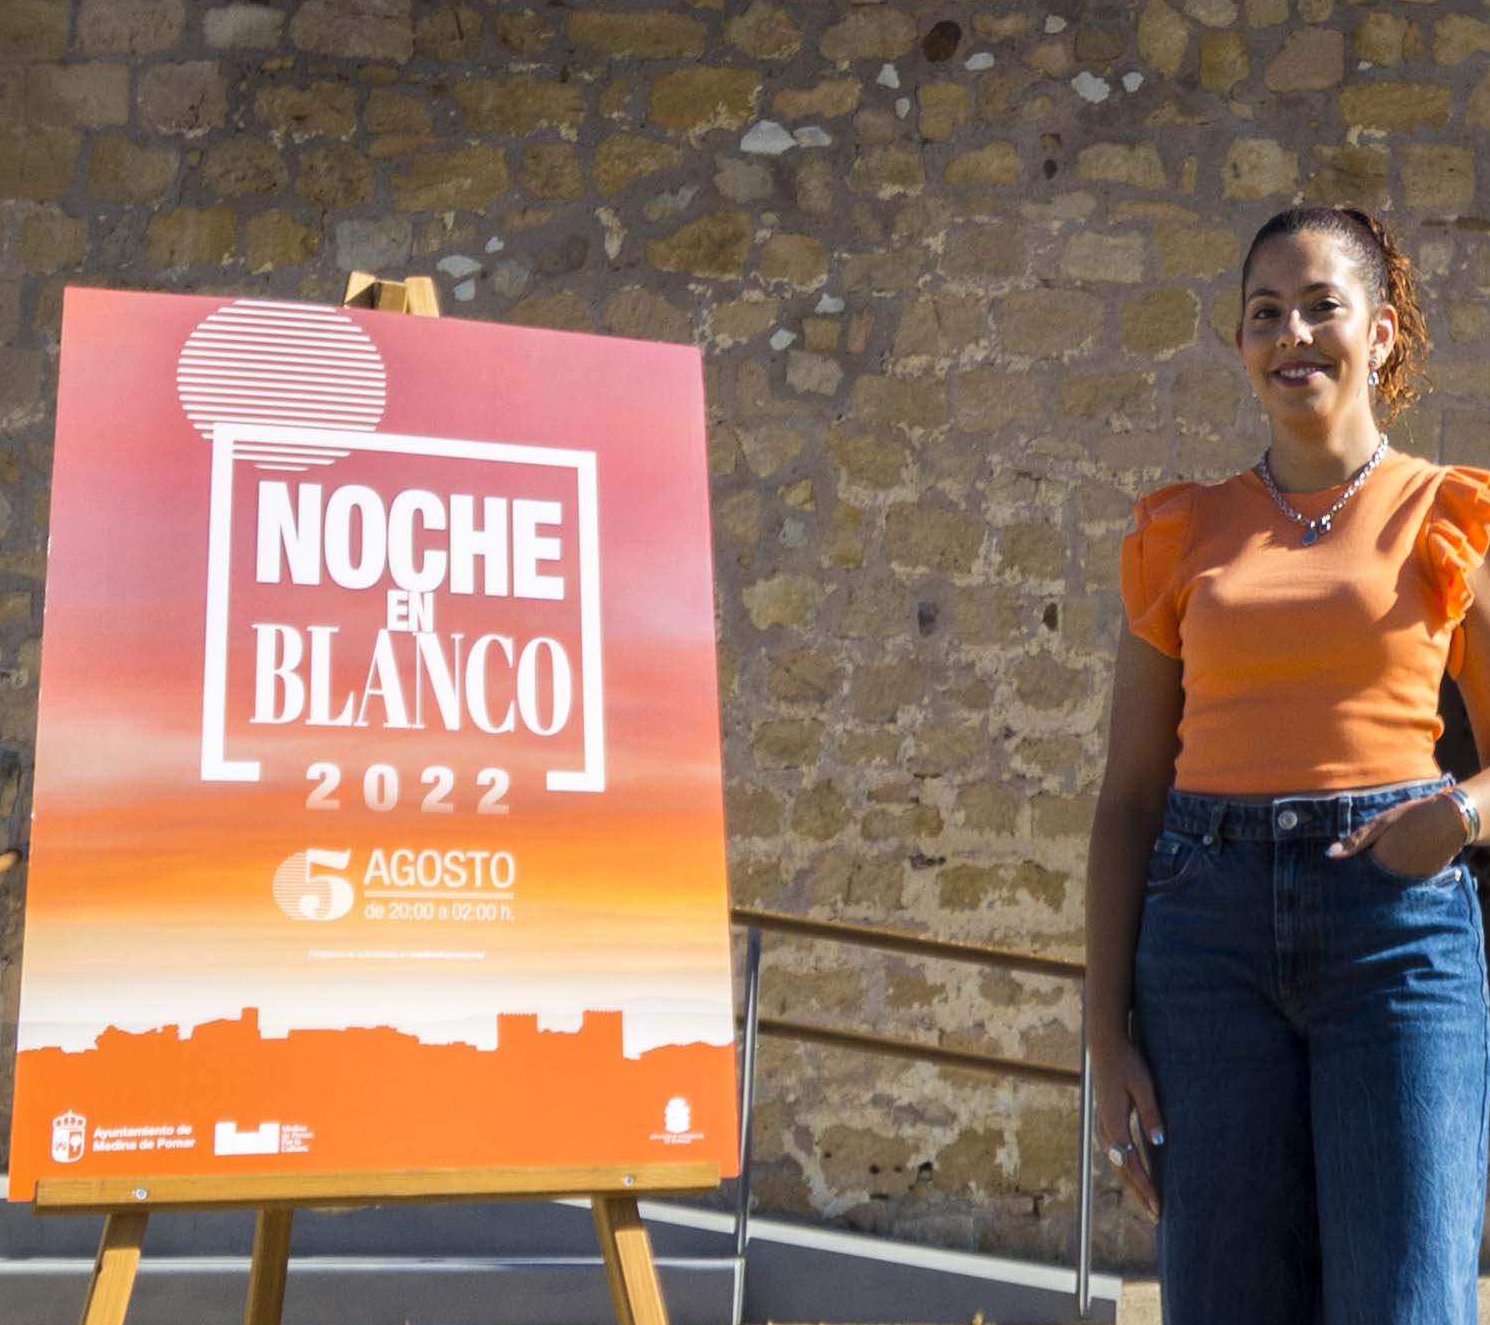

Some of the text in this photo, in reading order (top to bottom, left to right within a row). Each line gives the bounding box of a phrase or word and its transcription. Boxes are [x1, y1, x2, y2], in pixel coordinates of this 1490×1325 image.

[256, 481, 565, 600] NOCHE
[387, 589, 435, 633] EN
[249, 624, 572, 736] BLANCO
[305, 762, 510, 814] 2022
[299, 848, 515, 921] 5 AGOSTO
[364, 902, 385, 919] de
[389, 902, 434, 920] 20:00
[452, 902, 496, 921] 02:00
[93, 1125, 174, 1140] Ayuntamiento
[93, 1139, 137, 1152] Medina
[156, 1138, 196, 1150] Pomar
